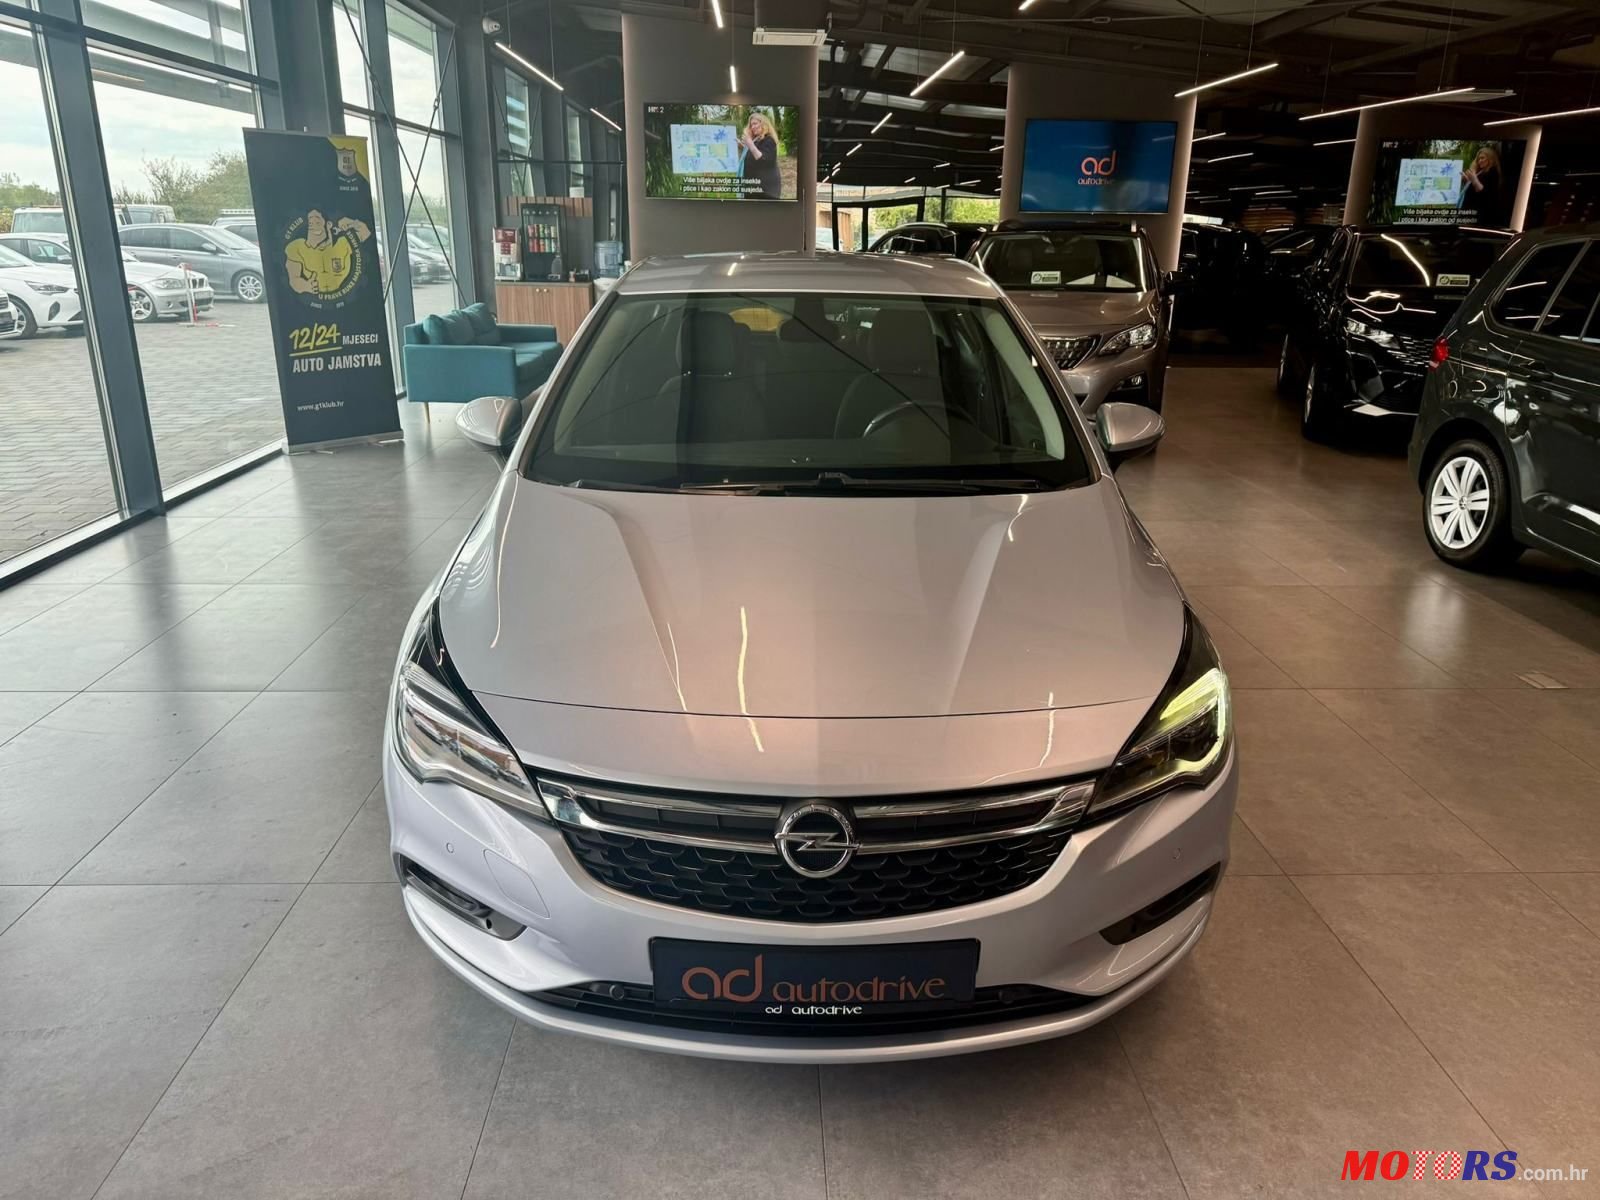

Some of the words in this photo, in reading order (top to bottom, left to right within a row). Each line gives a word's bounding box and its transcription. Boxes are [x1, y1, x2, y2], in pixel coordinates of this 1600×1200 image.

[1081, 150, 1117, 176] ad
[289, 323, 341, 350] 12/24
[342, 333, 378, 345] MJESECI
[293, 357, 324, 373] AUTO
[328, 353, 381, 370] JAMSTVA
[297, 400, 344, 411] www.g1klub.hr
[681, 954, 763, 1002] ad
[772, 976, 945, 1001] autodrive
[765, 1004, 783, 1014] ad
[791, 1005, 862, 1015] autodrive
